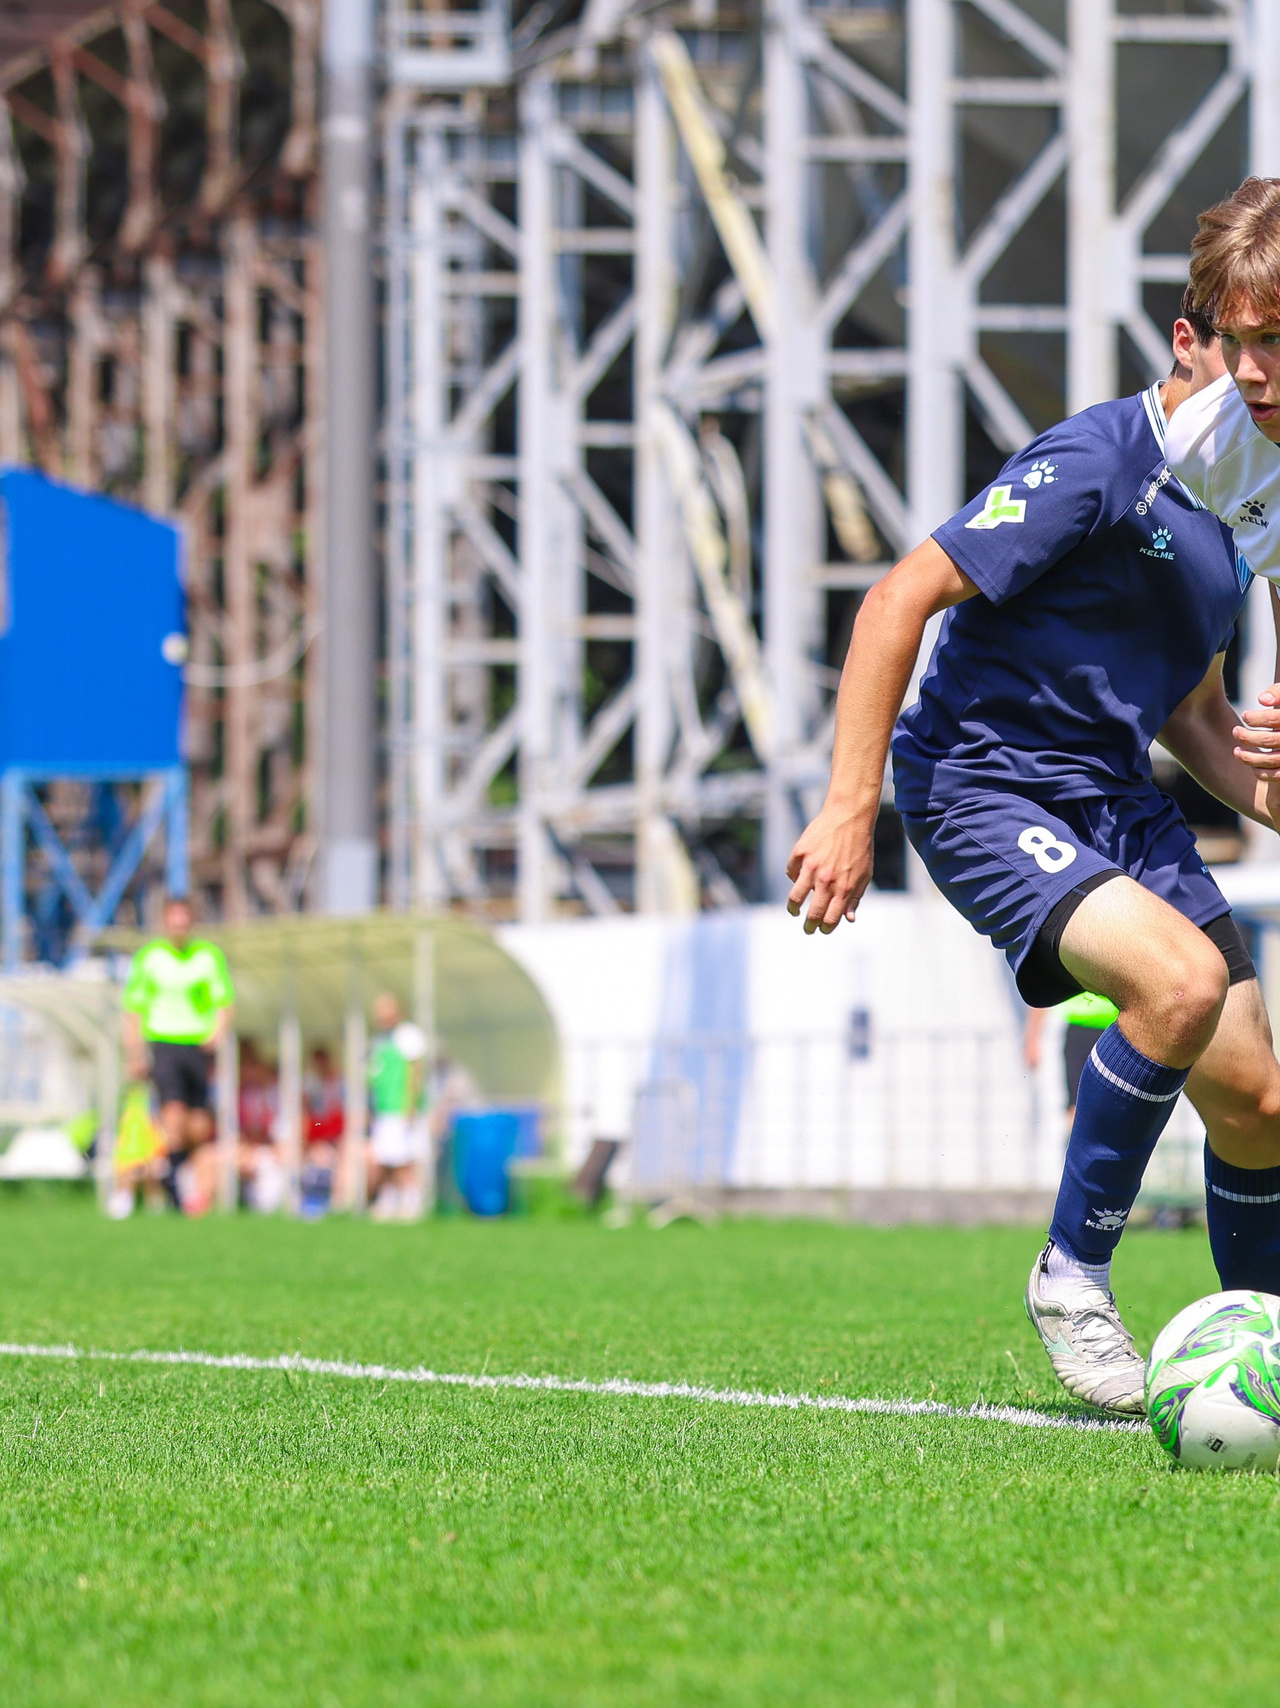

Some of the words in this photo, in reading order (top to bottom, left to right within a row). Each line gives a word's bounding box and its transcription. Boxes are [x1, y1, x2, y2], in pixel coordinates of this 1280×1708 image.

[1239, 515, 1270, 529] KELM
[1139, 547, 1175, 560] KELME
[1017, 825, 1077, 874] 8
